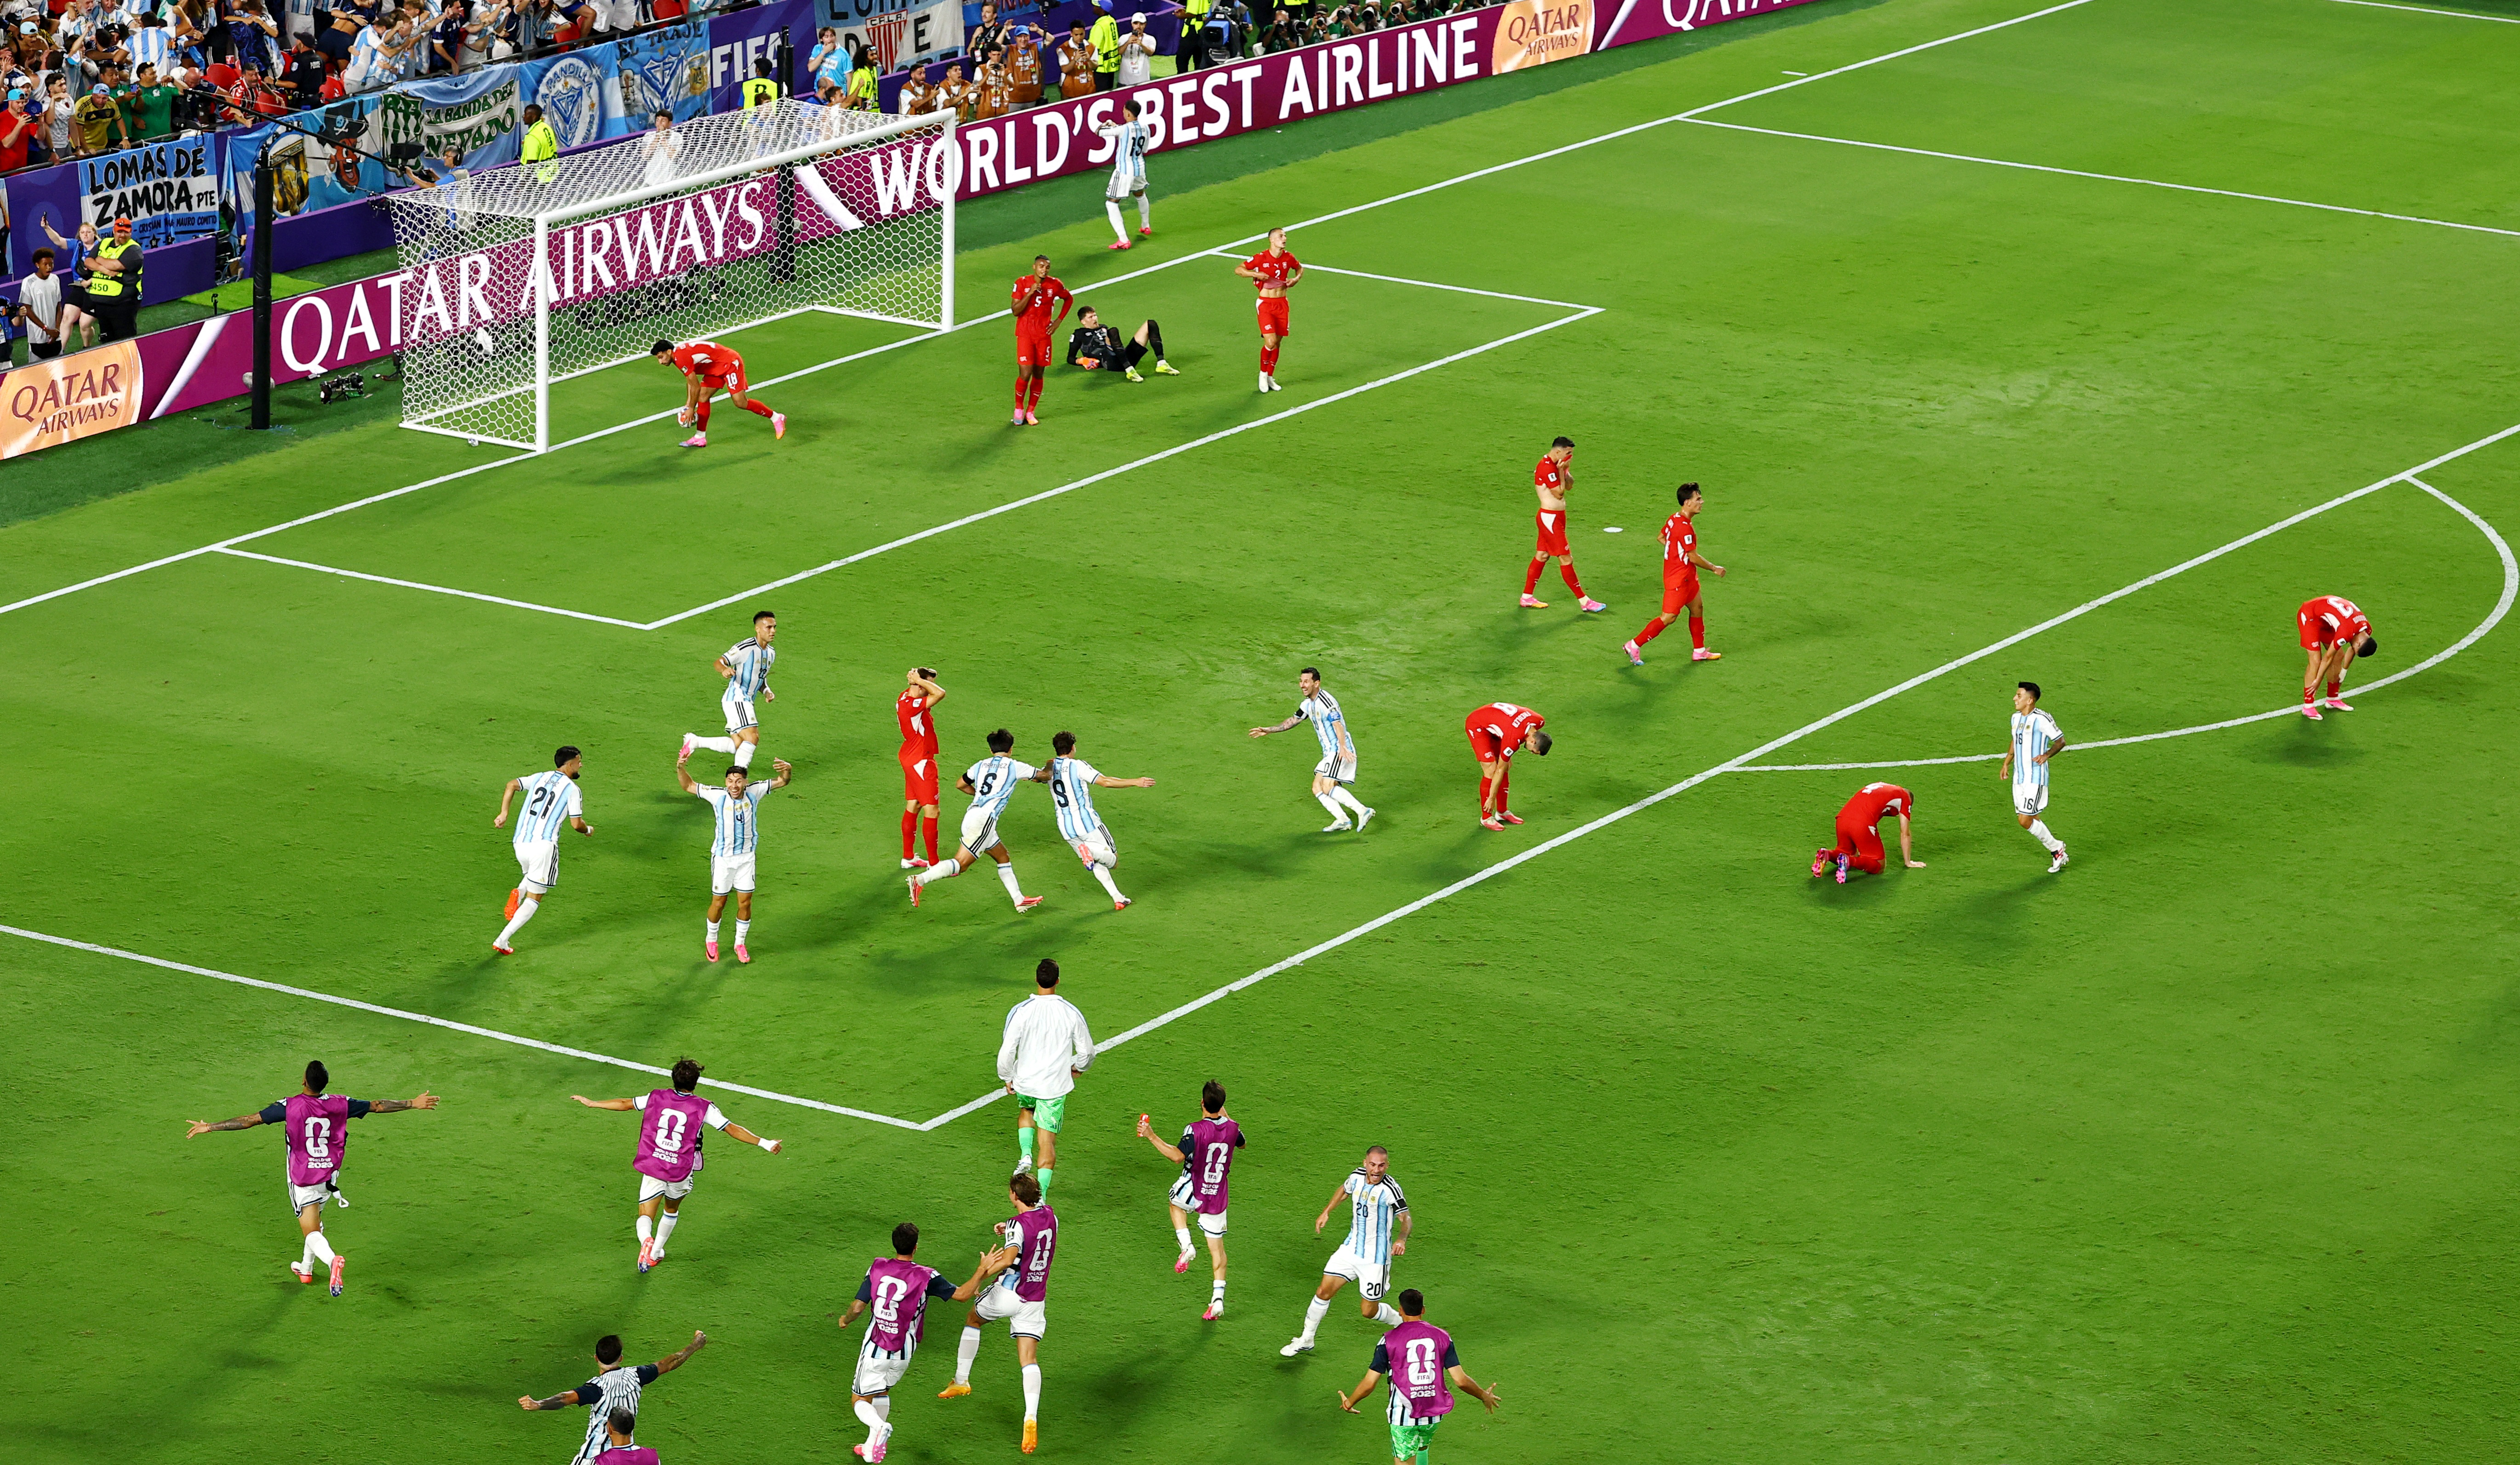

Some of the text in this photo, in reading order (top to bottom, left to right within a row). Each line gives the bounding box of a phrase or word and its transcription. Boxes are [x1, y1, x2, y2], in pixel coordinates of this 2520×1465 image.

[1508, 4, 1580, 46] QATAR
[1524, 32, 1578, 57] AIRWAYS
[712, 32, 782, 88] FIFA
[445, 94, 493, 122] BANDA
[871, 17, 1478, 216] WORLD'S BEST AIRLINE
[1129, 136, 1145, 156] 19
[88, 145, 207, 196] LOMAS DE
[92, 180, 216, 229] ZAMORA PTE
[520, 182, 765, 312] AIRWAYS
[92, 283, 109, 292] 450
[281, 253, 493, 374] QATAR
[1034, 296, 1042, 307] 5
[726, 372, 738, 386] 18
[12, 363, 120, 423] QATAR
[37, 398, 119, 436] AIRWAYS
[2016, 733, 2022, 745] 16
[529, 786, 556, 819] 21
[1053, 779, 1069, 808] 9
[2023, 797, 2033, 810] 16
[652, 1151, 677, 1164] 2026
[1356, 1202, 1369, 1218] 20
[1366, 1282, 1381, 1296] 20
[877, 1324, 899, 1334] 026
[1409, 1391, 1436, 1399] 2026
